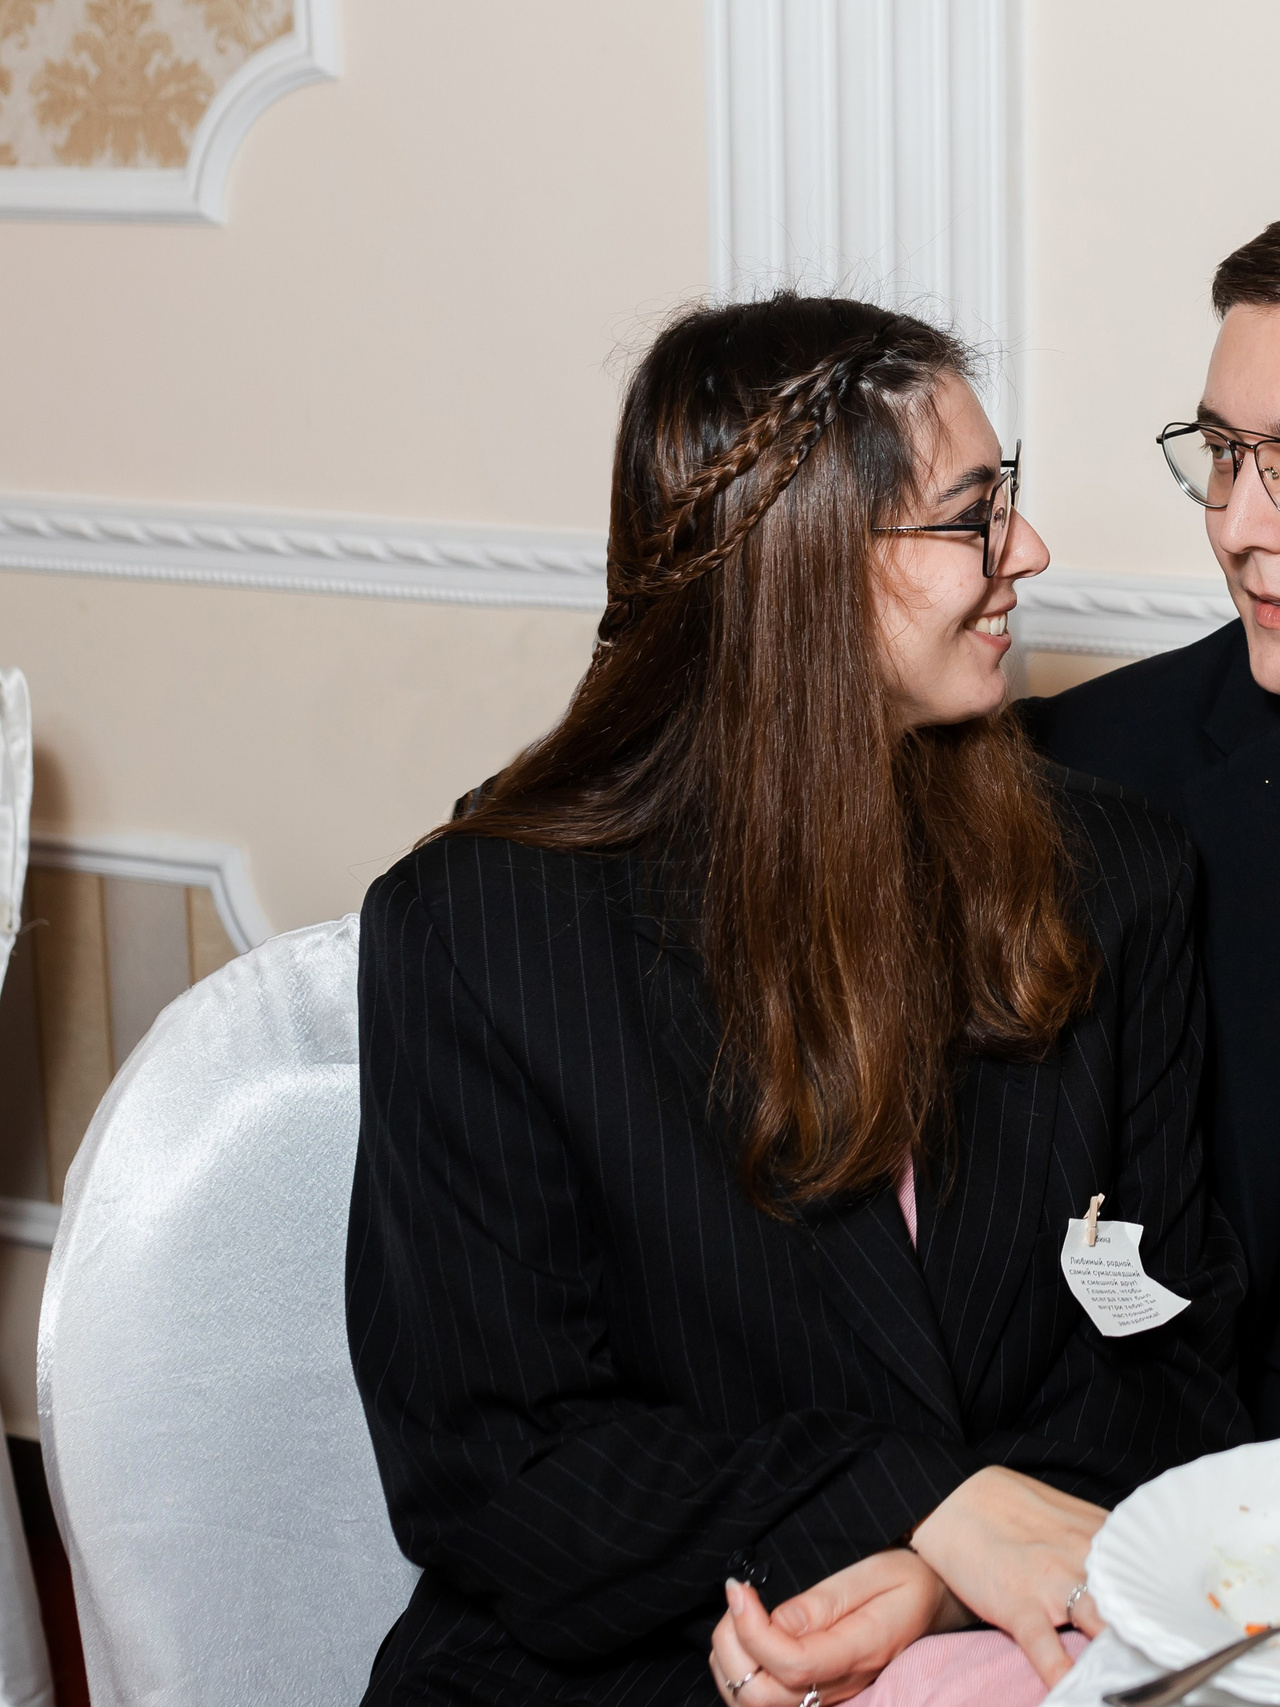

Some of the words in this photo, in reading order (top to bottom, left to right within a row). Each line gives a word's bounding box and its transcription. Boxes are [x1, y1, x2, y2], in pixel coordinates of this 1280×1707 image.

[1070, 1256, 1106, 1267] Любимый,
[1106, 1259, 1134, 1268] родной,
[1069, 1268, 1092, 1276] самый
[1093, 1270, 1141, 1278] сумасшедший
[1087, 1278, 1119, 1286] смешной
